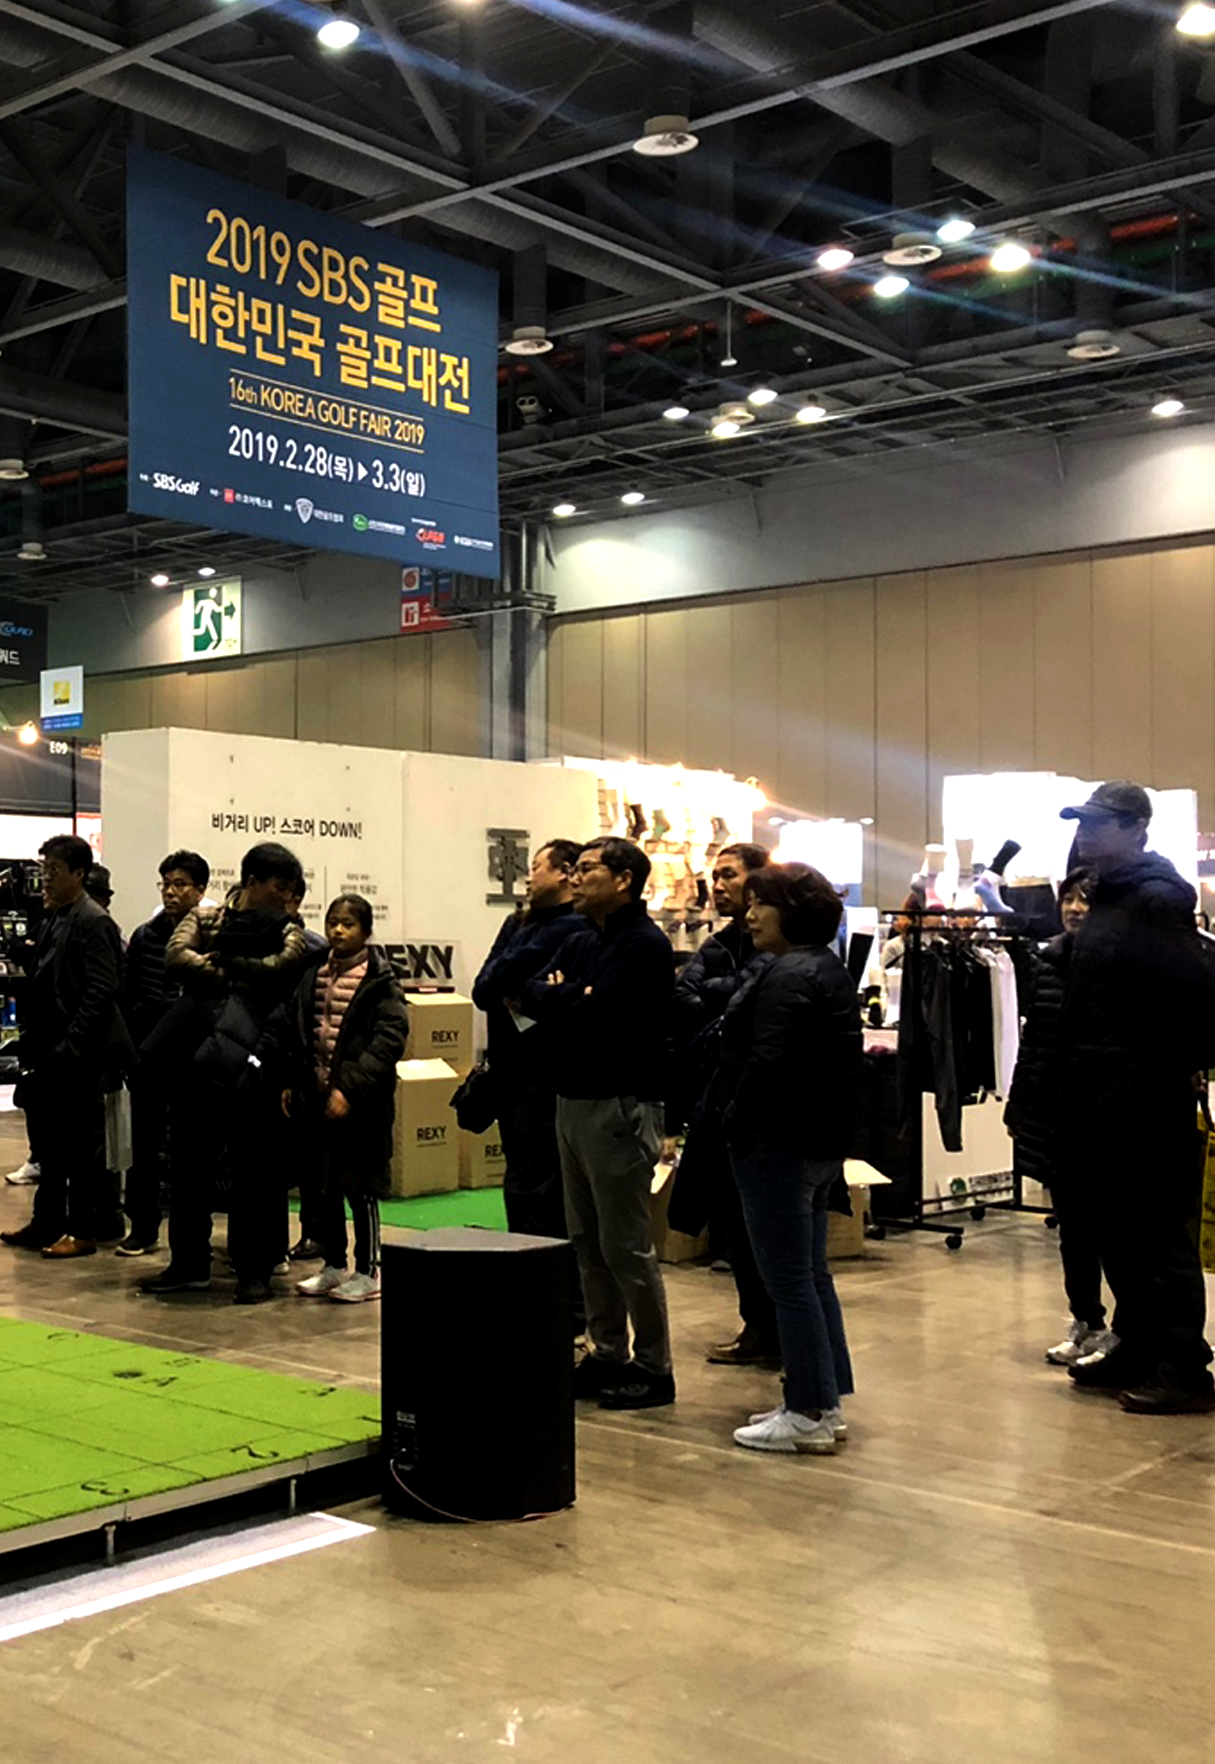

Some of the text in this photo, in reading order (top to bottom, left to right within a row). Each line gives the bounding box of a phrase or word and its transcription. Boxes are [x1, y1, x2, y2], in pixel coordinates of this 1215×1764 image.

[170, 274, 470, 414] 대한민국 골프대전
[229, 376, 425, 446] 16th KOREA GOLF FAIR 2019
[49, 741, 68, 755] E09
[211, 812, 363, 840] 비거리 UP! 스코어 DOWN!
[432, 1030, 459, 1043] REXY
[417, 1125, 447, 1141] REXY
[485, 1144, 503, 1158] REX
